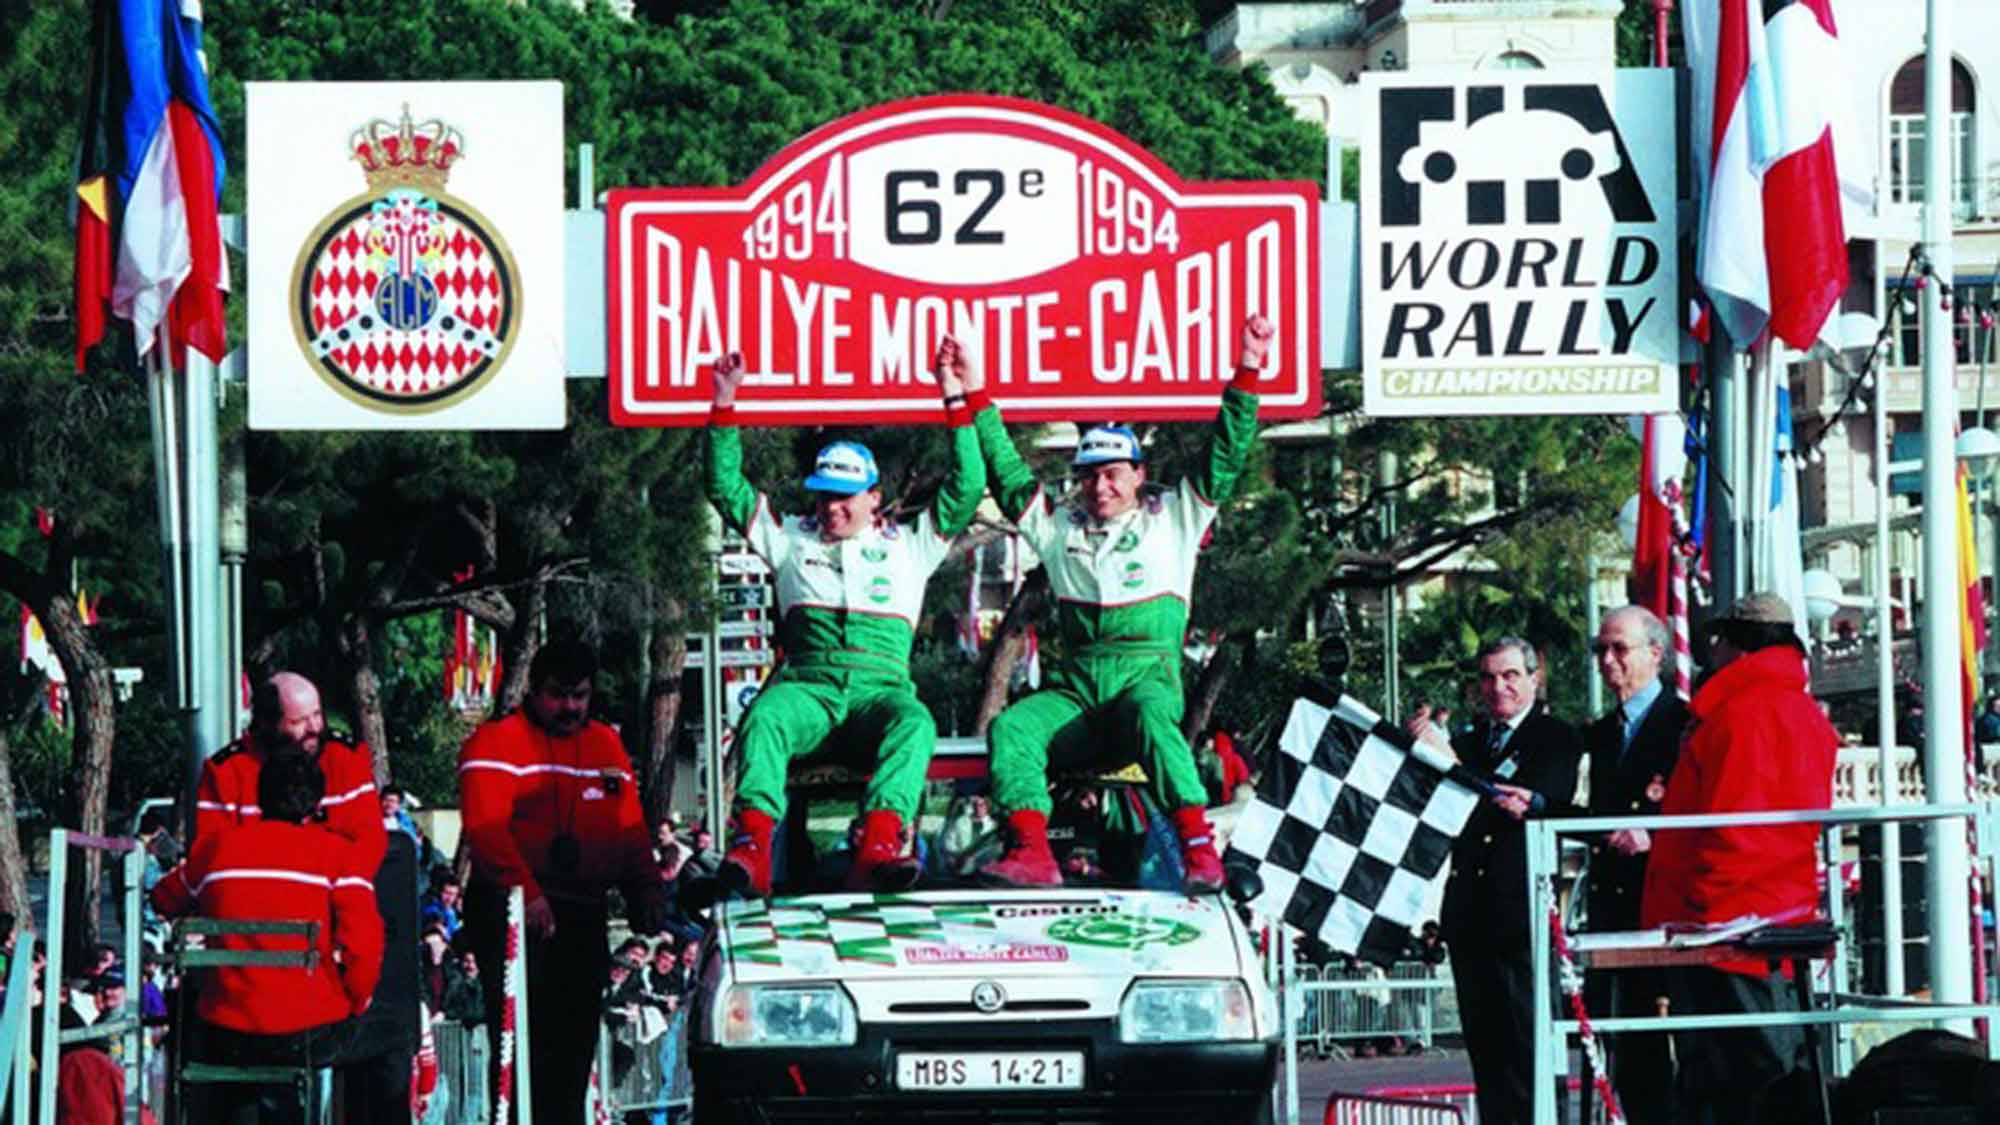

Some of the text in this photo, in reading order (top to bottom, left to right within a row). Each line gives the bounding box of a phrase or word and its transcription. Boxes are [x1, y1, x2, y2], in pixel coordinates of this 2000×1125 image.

[742, 152, 848, 260] 1994
[1079, 159, 1180, 256] 1994
[1380, 236, 1660, 291] WORLD
[647, 220, 1281, 387] RALLYE MONTE-CARLO
[1381, 297, 1657, 358] RALLY
[1385, 368, 1654, 394] CHAMPIONSHIP
[995, 904, 1120, 918] Castrol
[914, 1059, 967, 1085] MBS
